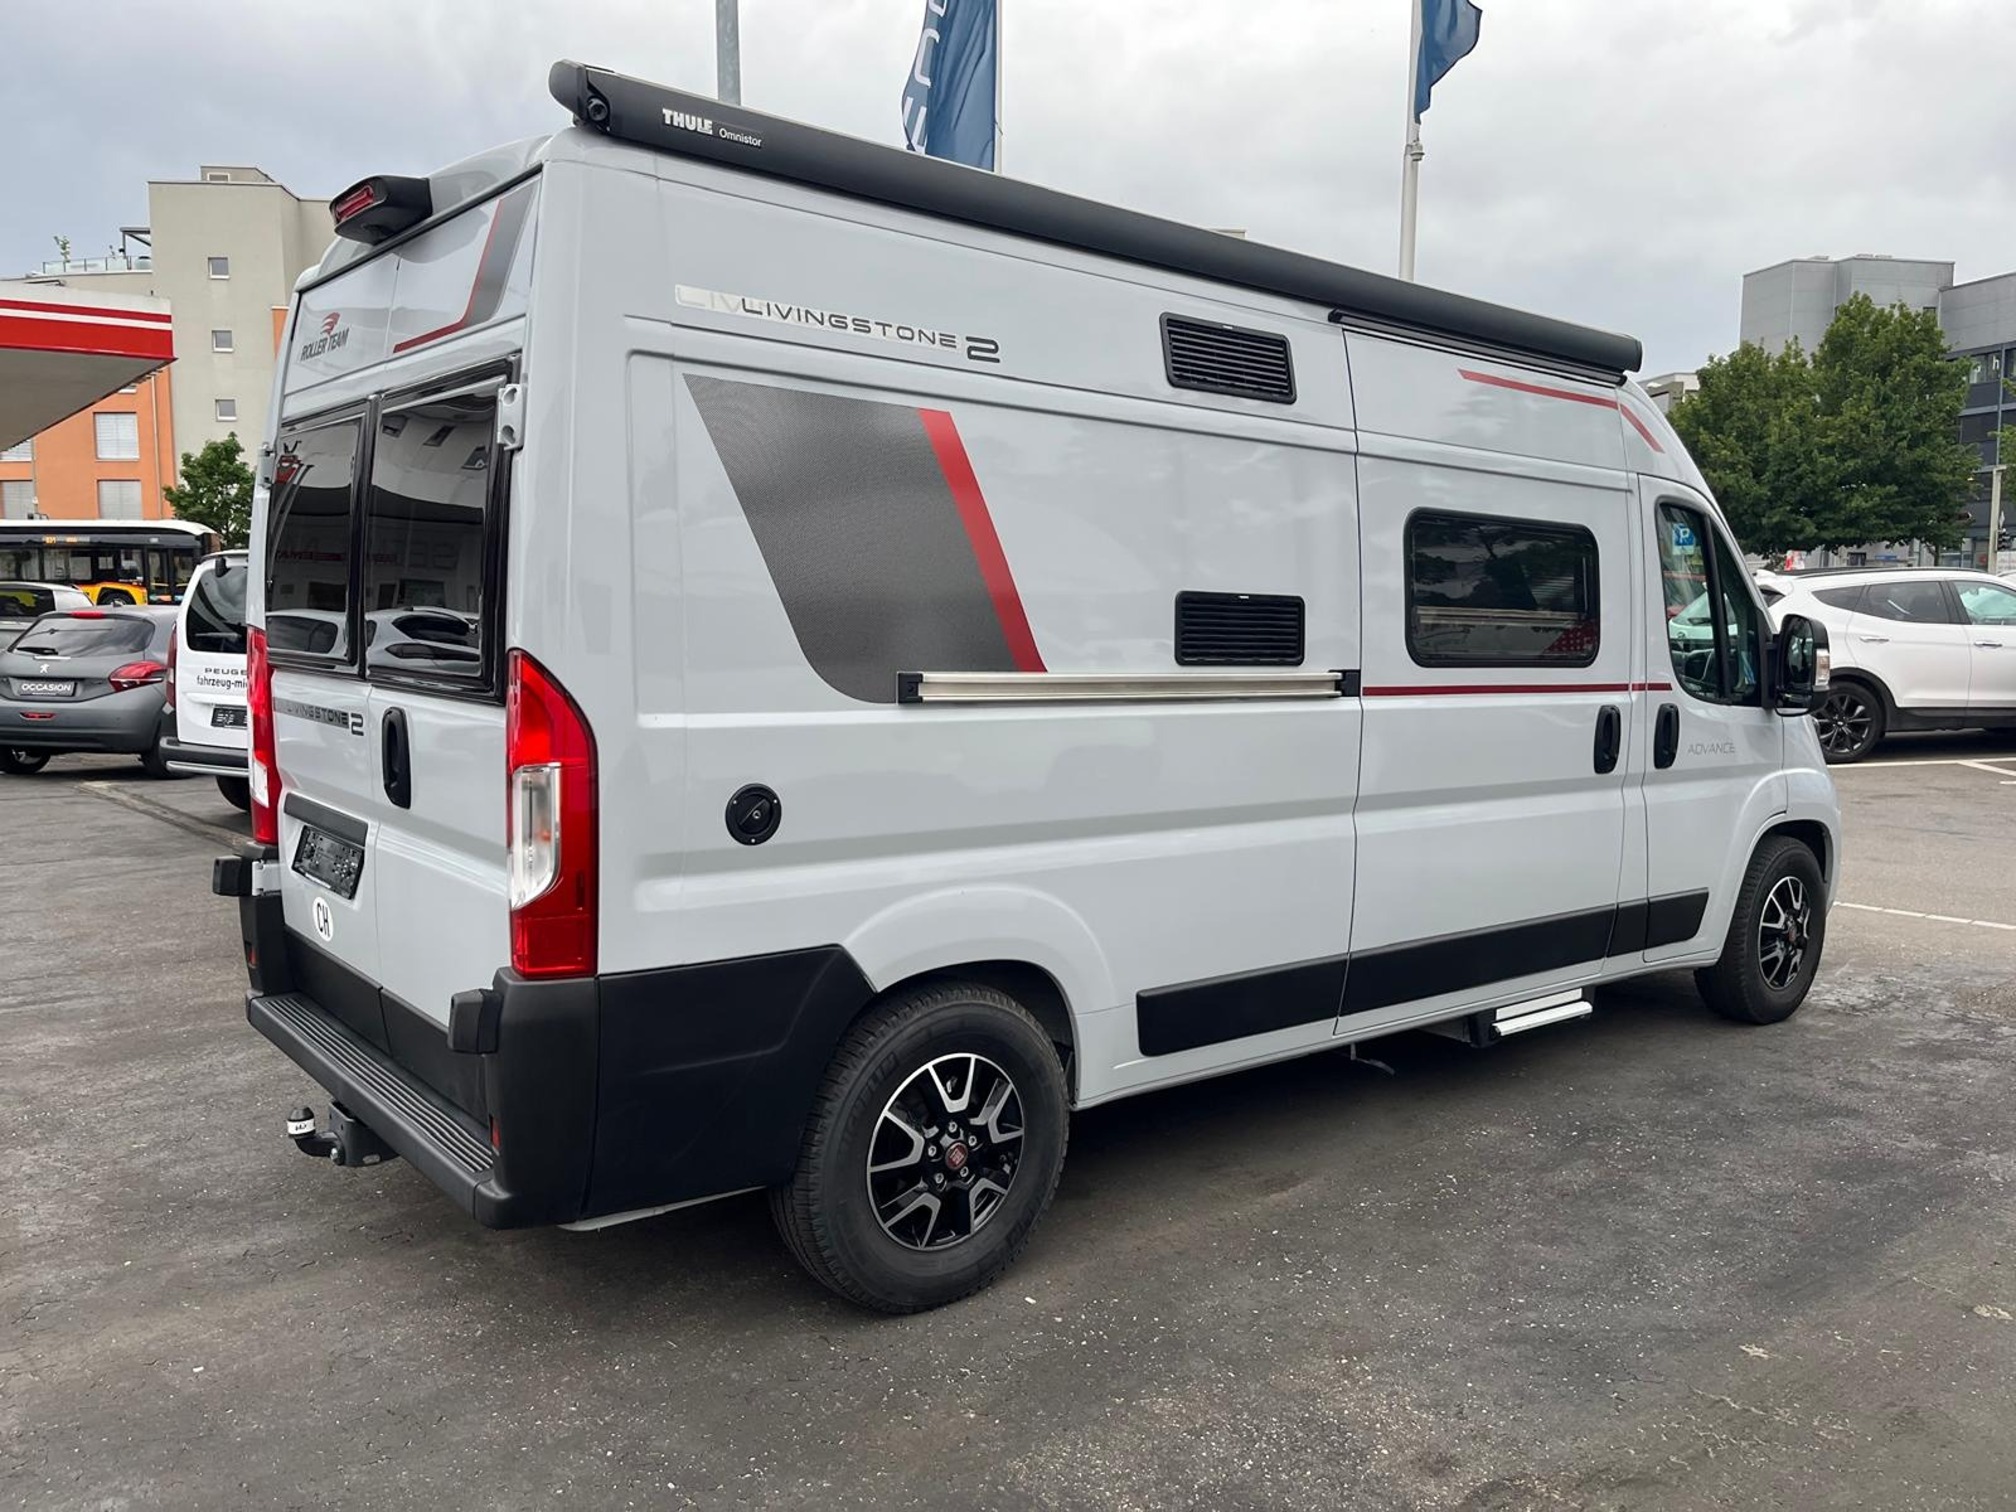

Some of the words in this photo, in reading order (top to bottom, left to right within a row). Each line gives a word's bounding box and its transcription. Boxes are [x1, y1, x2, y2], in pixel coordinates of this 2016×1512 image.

[662, 107, 713, 135] THULE
[719, 127, 762, 148] Omnistor
[300, 337, 328, 361] ROLLER
[328, 327, 349, 352] TEAM
[741, 297, 957, 349] LIVINGSTONE
[965, 335, 1000, 364] 2
[21, 683, 72, 692] OCCASION
[350, 712, 365, 737] 2
[1687, 742, 1736, 756] ADVANCE
